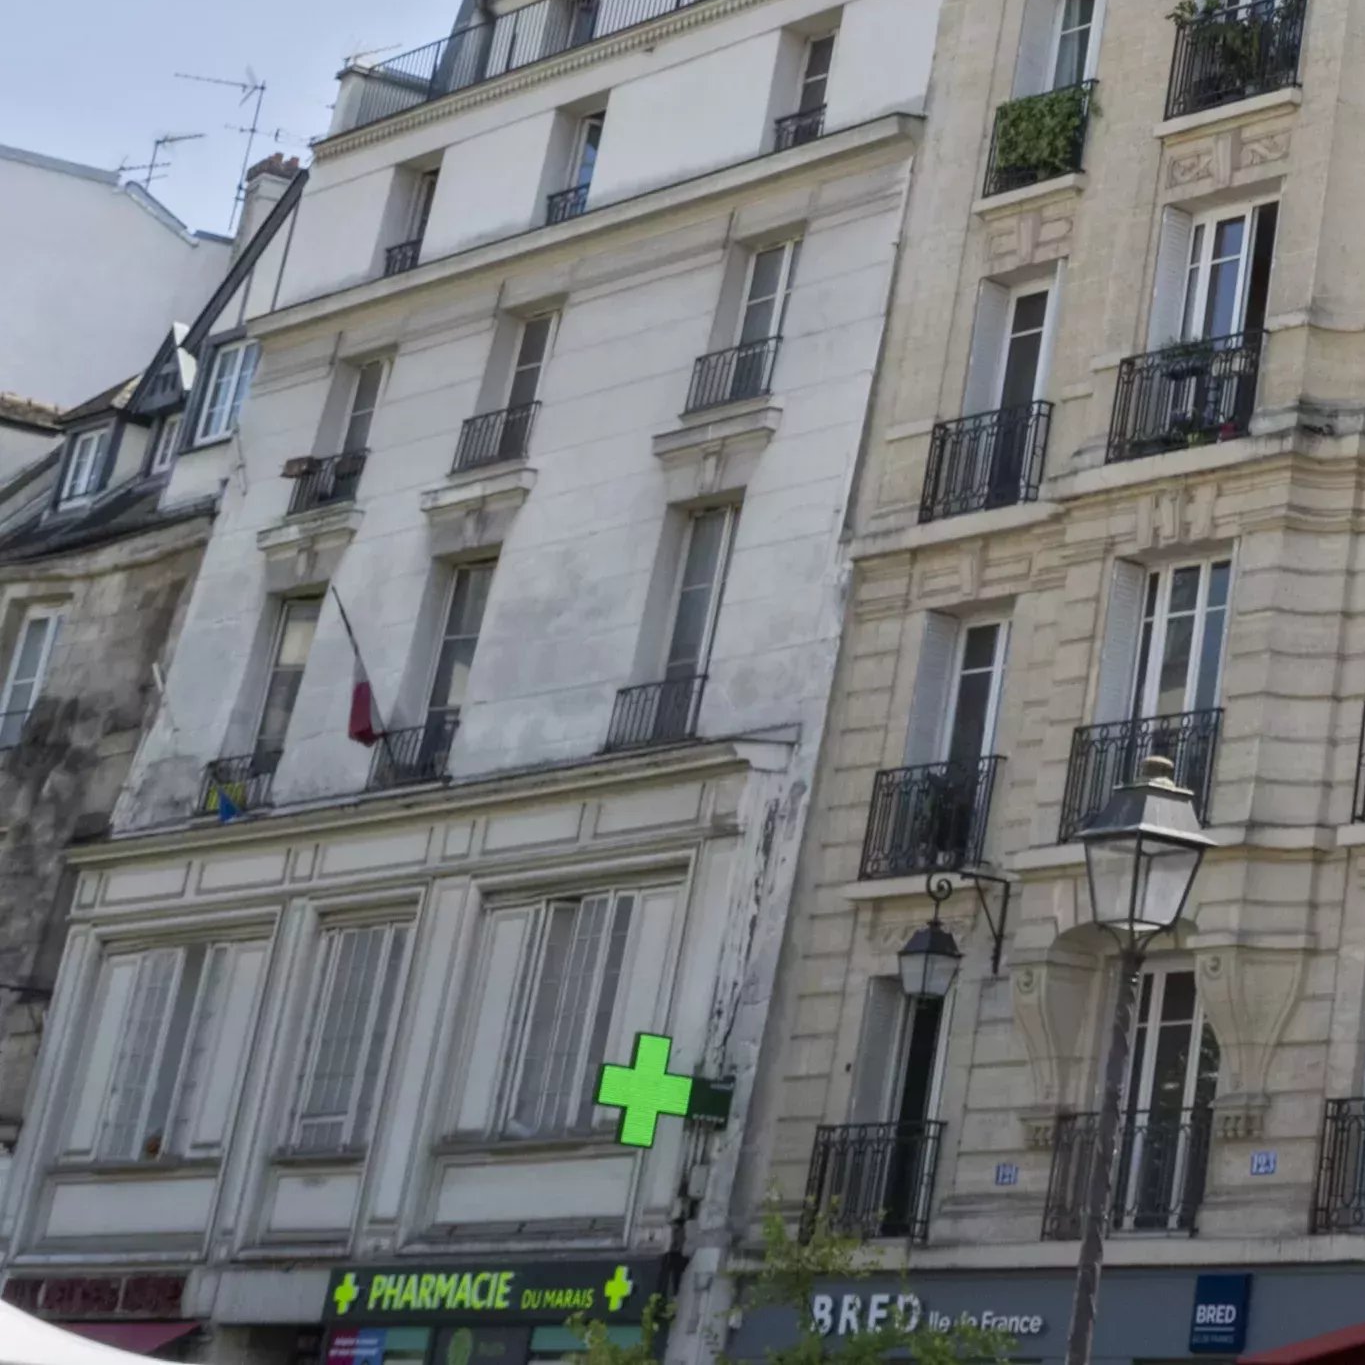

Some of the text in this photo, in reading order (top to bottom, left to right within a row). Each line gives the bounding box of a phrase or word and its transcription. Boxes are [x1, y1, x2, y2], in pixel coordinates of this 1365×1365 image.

[368, 1271, 595, 1311] PHARMACIE DU MARAIS
[810, 1293, 921, 1334] BRED
[981, 1310, 1042, 1333] France
[1196, 1304, 1237, 1324] BRED
